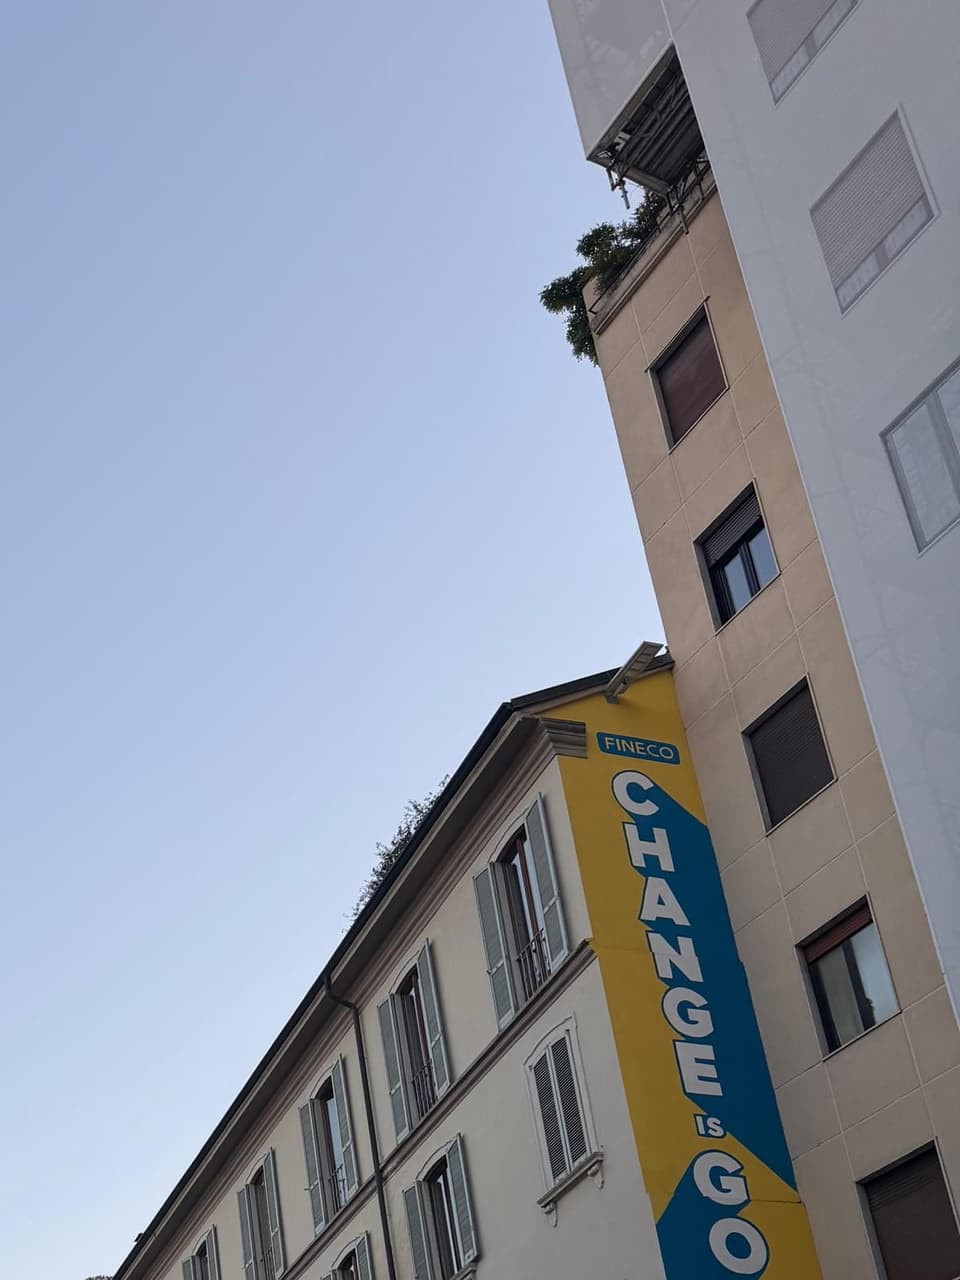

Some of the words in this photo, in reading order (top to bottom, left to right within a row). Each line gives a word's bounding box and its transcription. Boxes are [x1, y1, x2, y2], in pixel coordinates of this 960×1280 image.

[603, 735, 676, 761] FINECO
[613, 770, 724, 1098] CHANGE
[696, 1114, 725, 1138] IS
